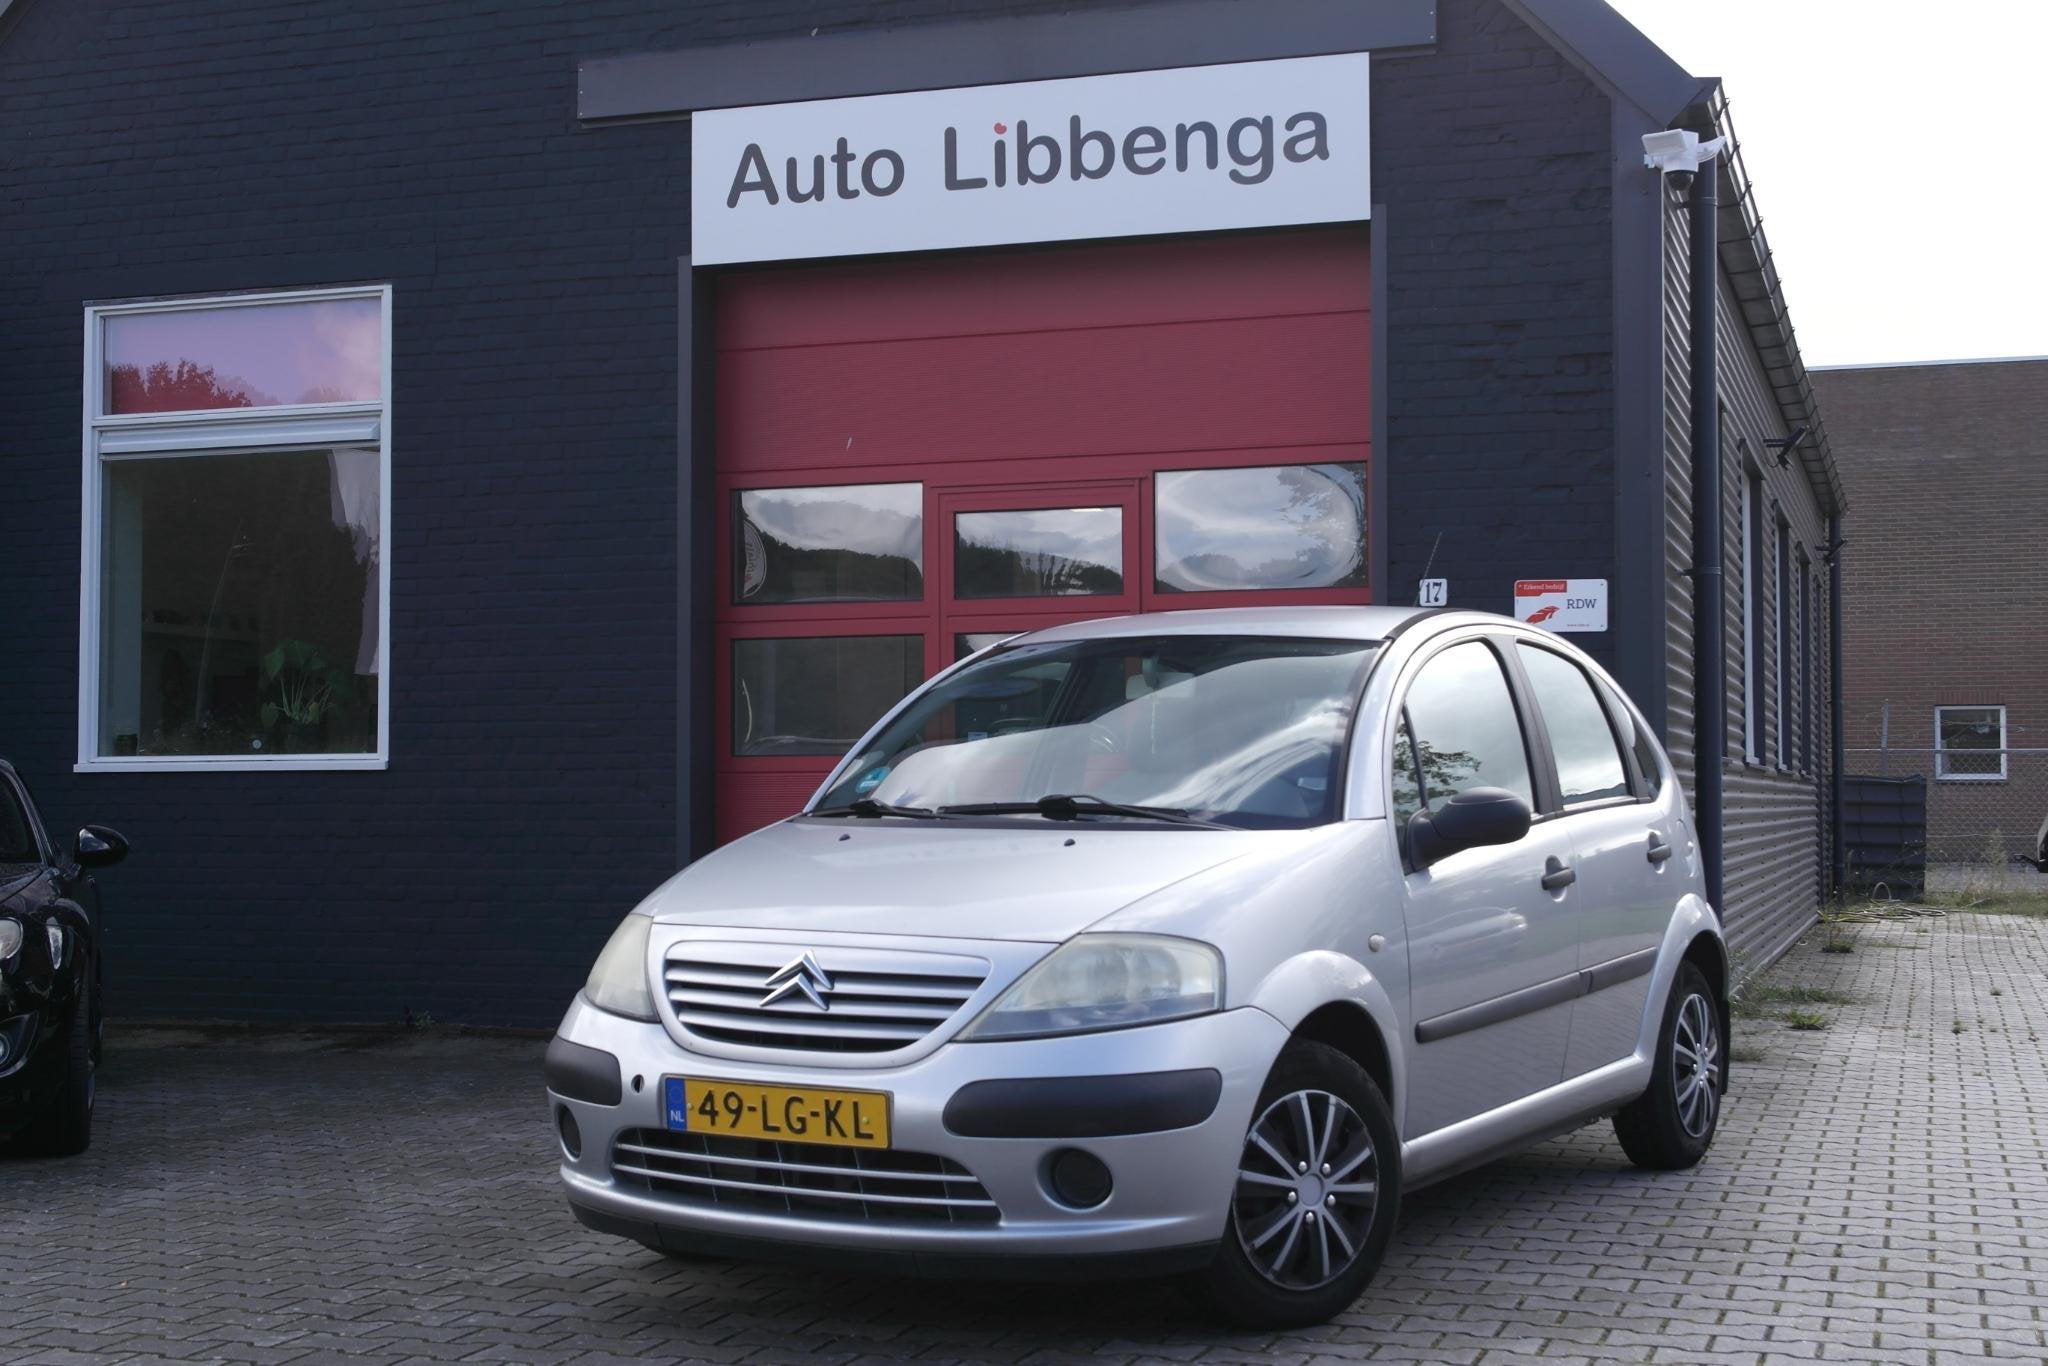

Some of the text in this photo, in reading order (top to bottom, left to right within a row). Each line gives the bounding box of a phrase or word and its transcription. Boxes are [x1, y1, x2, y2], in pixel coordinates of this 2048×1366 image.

[726, 110, 1330, 209] Auto Libbenga
[1424, 581, 1443, 604] 17
[1566, 598, 1597, 609] RDW
[670, 1109, 685, 1122] NL
[698, 1089, 875, 1140] 49-LG-KL
